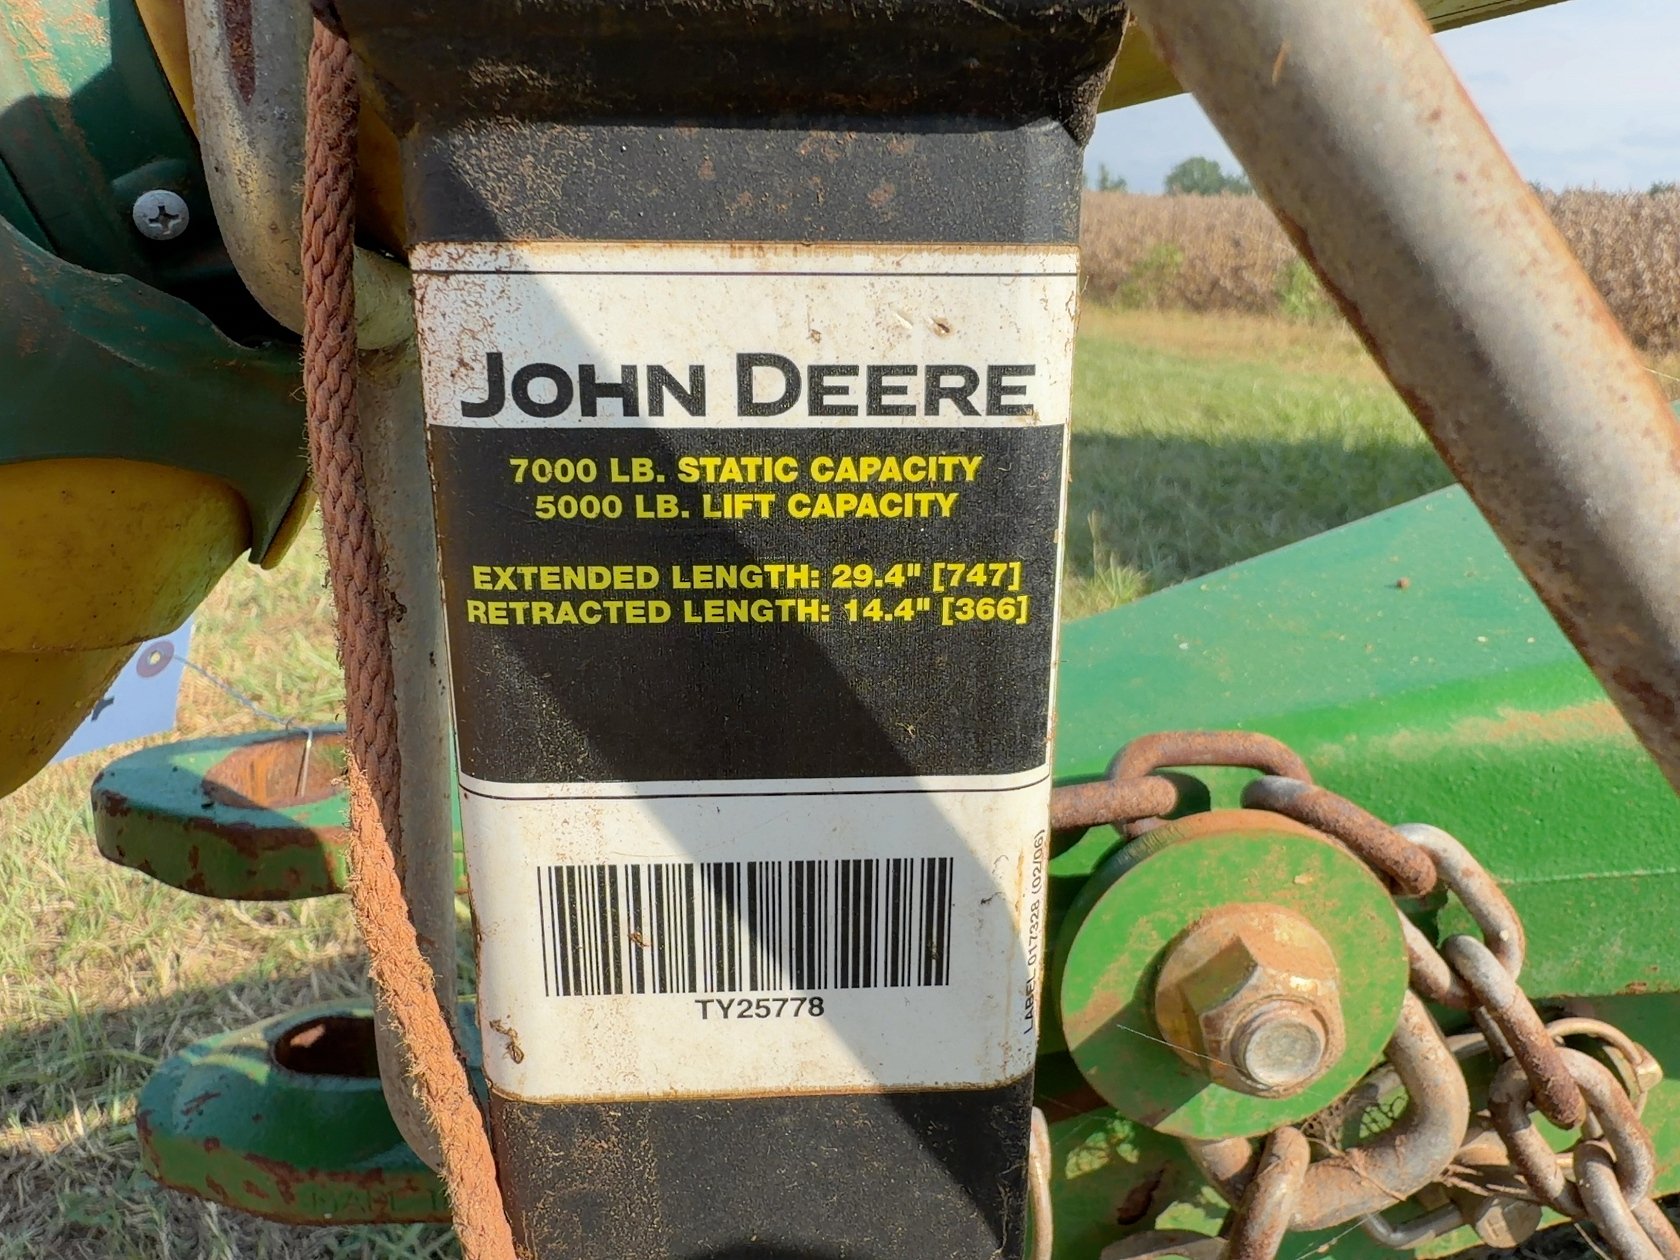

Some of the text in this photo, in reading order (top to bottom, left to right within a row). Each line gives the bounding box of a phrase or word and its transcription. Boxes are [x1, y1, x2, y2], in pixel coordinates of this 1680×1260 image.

[461, 352, 1036, 418] JOHN DEERE
[510, 456, 983, 483] 7000 LB. STATIC CAPACITY
[535, 493, 958, 519] 5000 LB. LIFT CAPACITY
[473, 562, 1021, 592] EXTENDED LENGTH: 29.4" [747]
[467, 596, 1029, 626] RETRACTED LENGTH: 14.4" [366]
[1024, 829, 1045, 1034] LABEL 017328 (02/06)
[695, 997, 825, 1019] TY25778
